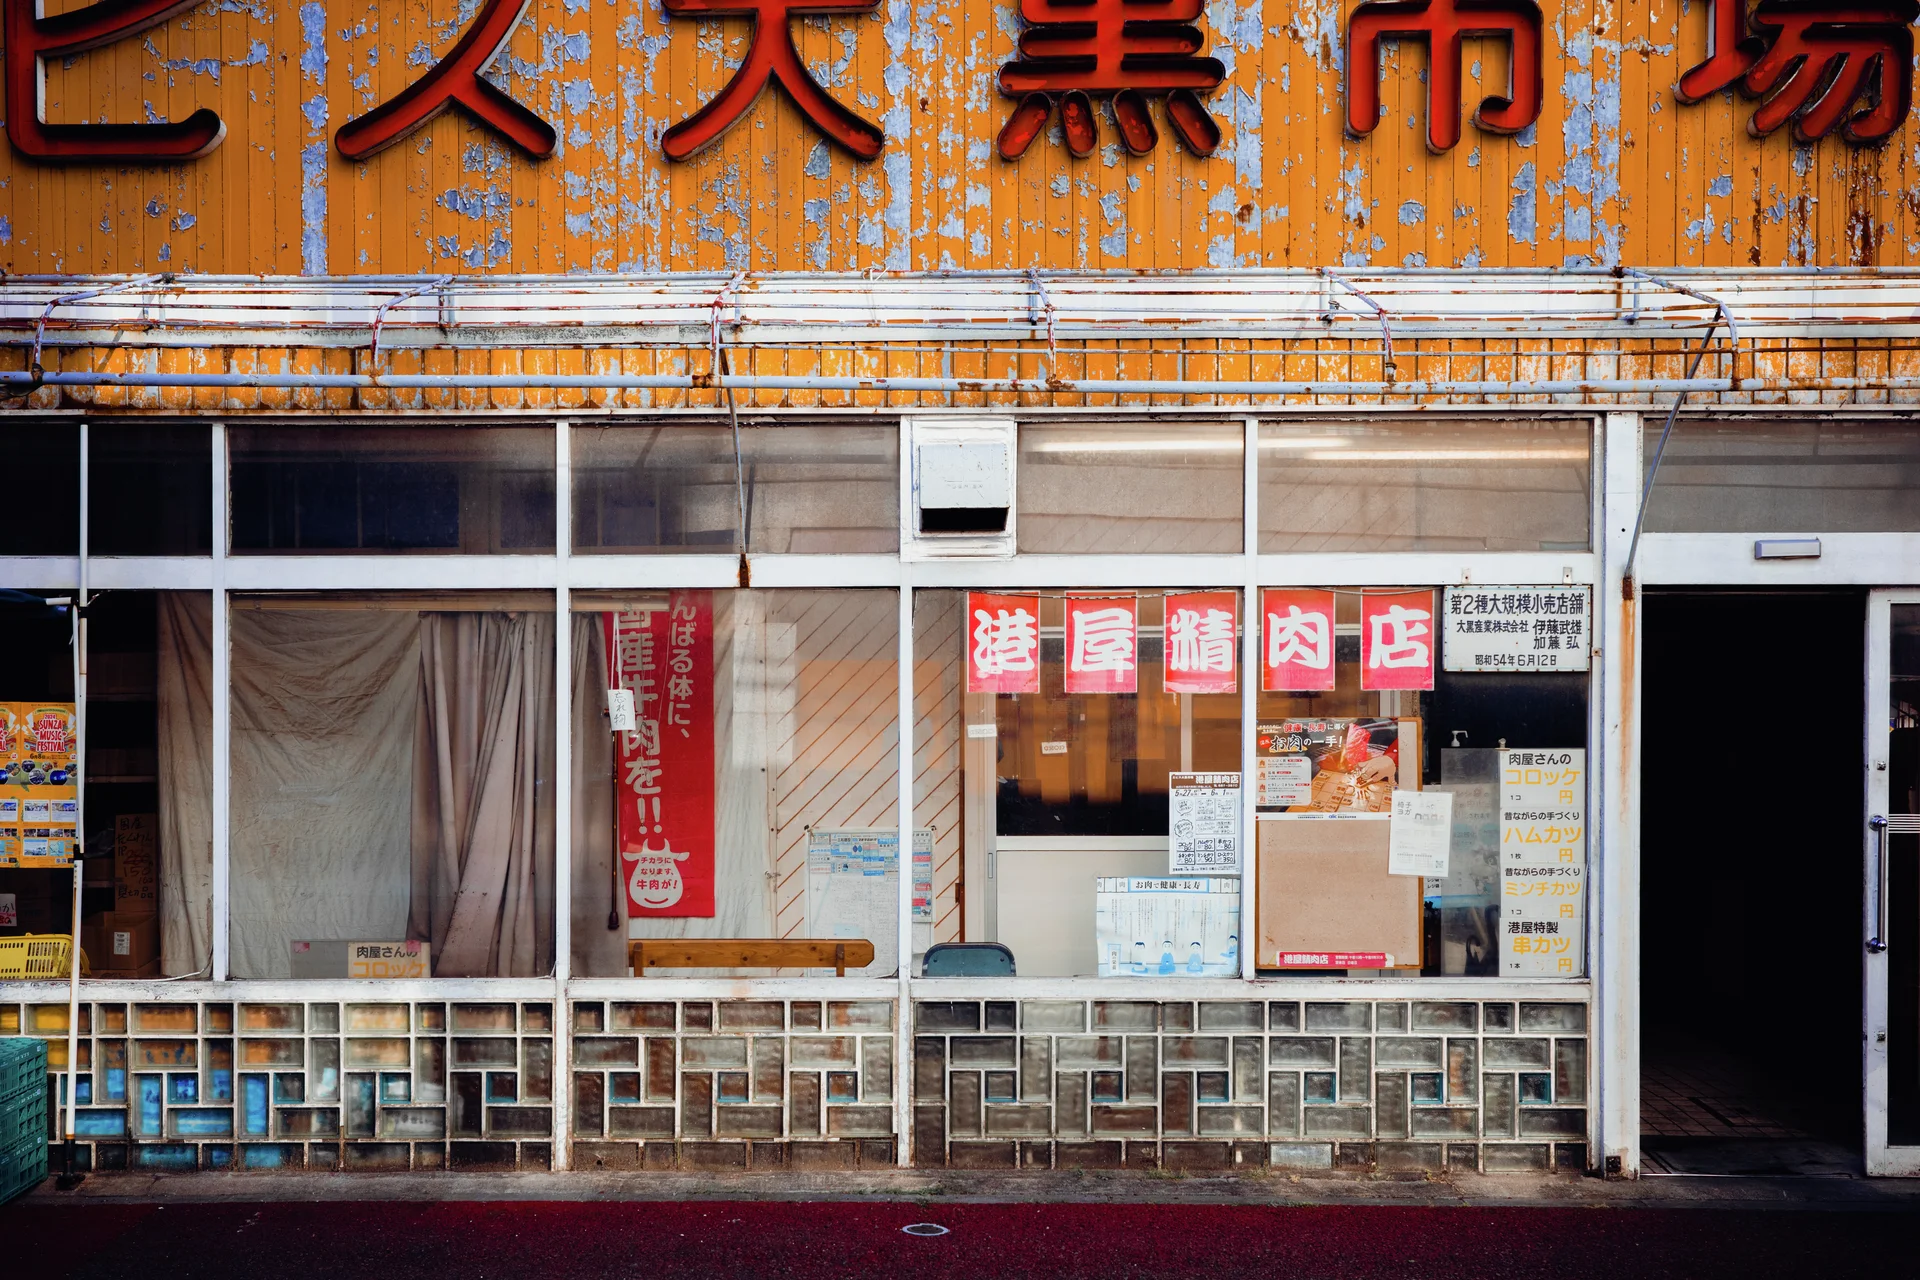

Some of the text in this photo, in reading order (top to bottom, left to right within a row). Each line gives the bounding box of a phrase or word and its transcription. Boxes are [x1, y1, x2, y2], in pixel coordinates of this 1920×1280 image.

[1451, 593, 1585, 615] 第2種大規模小売店舗
[1457, 619, 1582, 635] 大黒産業株式会社 伊藤武雄
[1475, 654, 1557, 667] 昭和54年6月12日
[614, 691, 627, 725] 忘れ物
[39, 719, 63, 730] SUNZA
[39, 730, 62, 741] MUSIC
[36, 741, 66, 752] FESTIVAL
[1509, 753, 1572, 766] 肉屋さんの
[1505, 768, 1581, 786] コロッケ
[1559, 789, 1573, 805] 円
[1397, 801, 1412, 809] 椅子
[1504, 812, 1580, 821] 昔ながらの手づくり
[1504, 825, 1582, 843] ハムカツ
[1559, 848, 1573, 863] 円
[641, 867, 675, 876] なります、
[1505, 868, 1581, 876] 昔ながらの手づくり
[637, 878, 678, 890] 牛肉が!
[1505, 881, 1581, 896] ミンチカツ
[1560, 904, 1574, 918] 円
[1508, 921, 1559, 934] 港屋特製
[1513, 936, 1571, 955] 串カツ
[353, 960, 427, 978] コロッケ
[1558, 957, 1573, 972] 円
